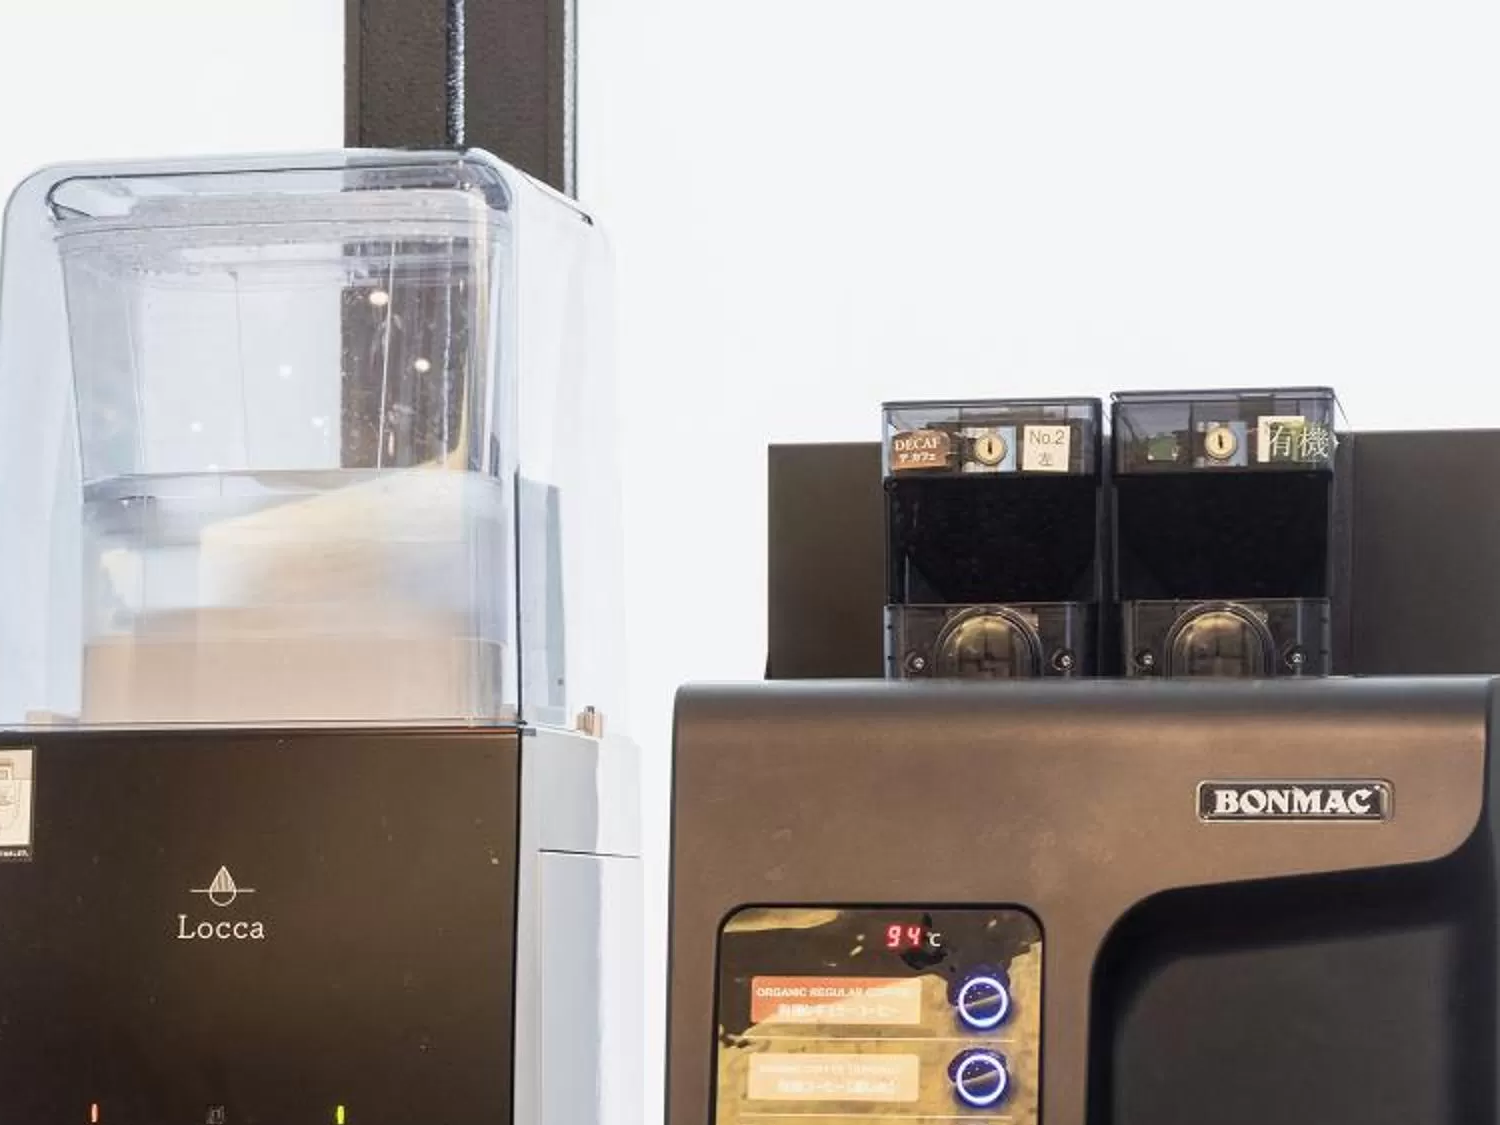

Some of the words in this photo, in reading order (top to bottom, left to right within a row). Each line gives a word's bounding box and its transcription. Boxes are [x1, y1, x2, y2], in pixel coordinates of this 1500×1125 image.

[894, 436, 942, 451] DECAF
[1028, 429, 1066, 446] No.2
[1268, 423, 1331, 459] 有機
[1213, 788, 1373, 814] BONMAC
[177, 913, 265, 939] Locca
[887, 925, 921, 947] 94
